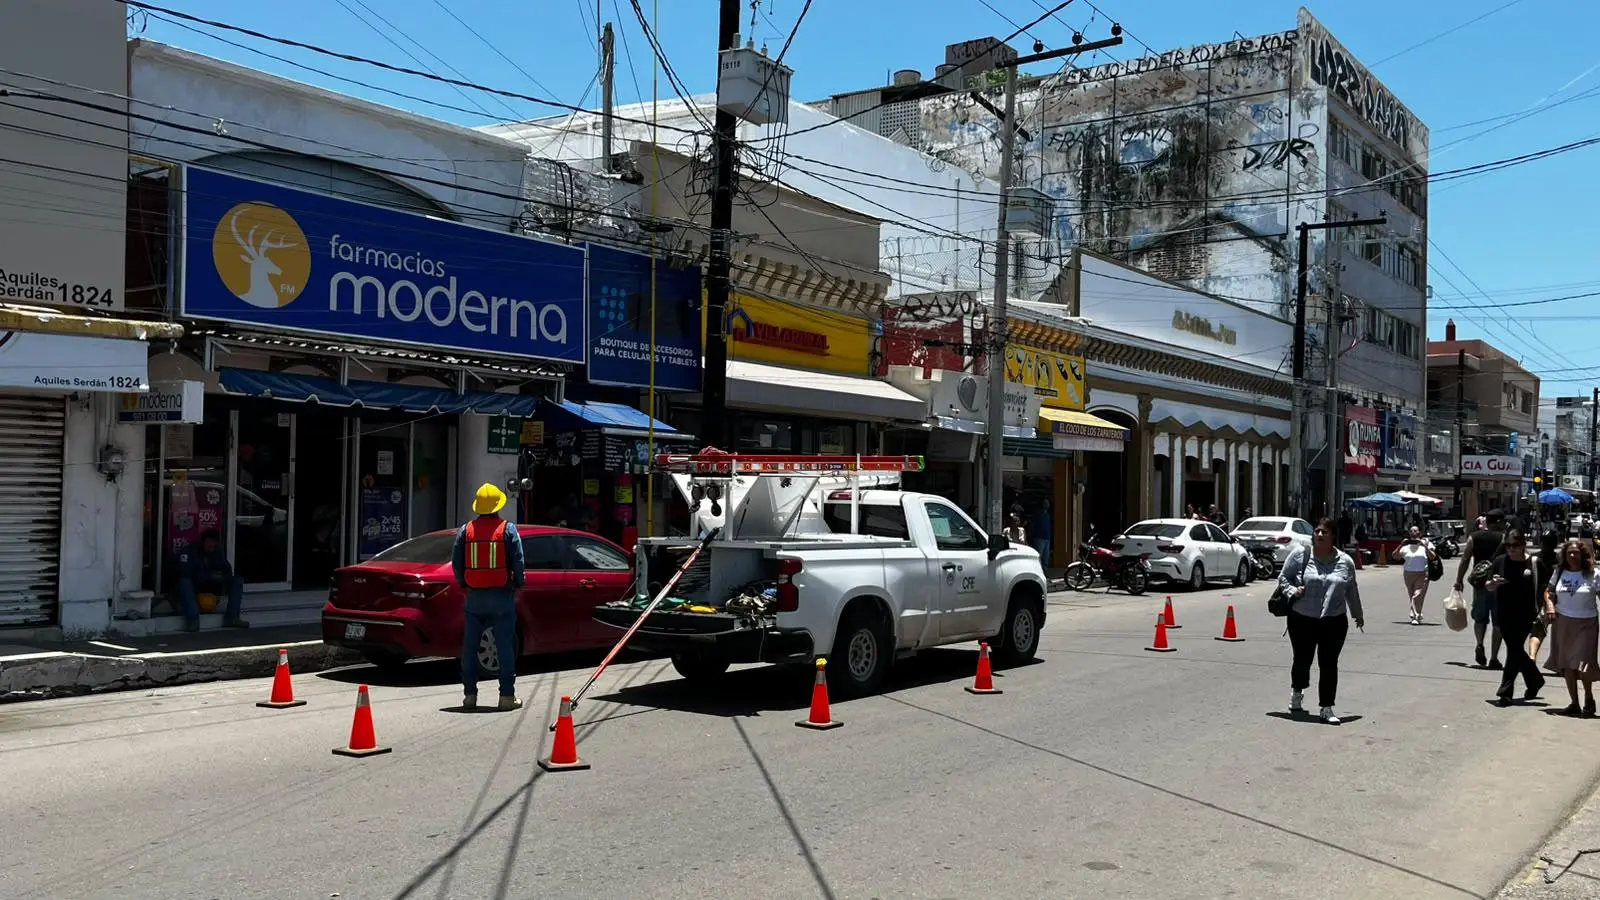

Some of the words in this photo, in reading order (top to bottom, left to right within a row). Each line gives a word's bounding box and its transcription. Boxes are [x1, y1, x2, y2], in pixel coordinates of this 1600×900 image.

[329, 234, 445, 278] farmacias
[0, 268, 58, 288] Aquiles
[0, 282, 54, 301] Serdán
[58, 283, 113, 307] 1824
[280, 284, 296, 295] FM
[329, 271, 567, 344] moderna
[600, 337, 638, 350] BOUTIQUE
[640, 342, 650, 353] DE
[594, 346, 616, 358] PARA
[618, 350, 660, 363] CELULARS
[661, 355, 667, 364] Y
[668, 355, 697, 367] TABLETS
[34, 375, 71, 387] Aquiles
[73, 377, 107, 388] Serdán
[108, 376, 141, 388] 1824
[139, 391, 182, 409] moderna
[1059, 422, 1066, 433] EL
[1065, 423, 1080, 435] COCO
[1080, 425, 1087, 436] DE
[1087, 426, 1097, 437] LOS
[1097, 428, 1124, 440] ZAPATEROS
